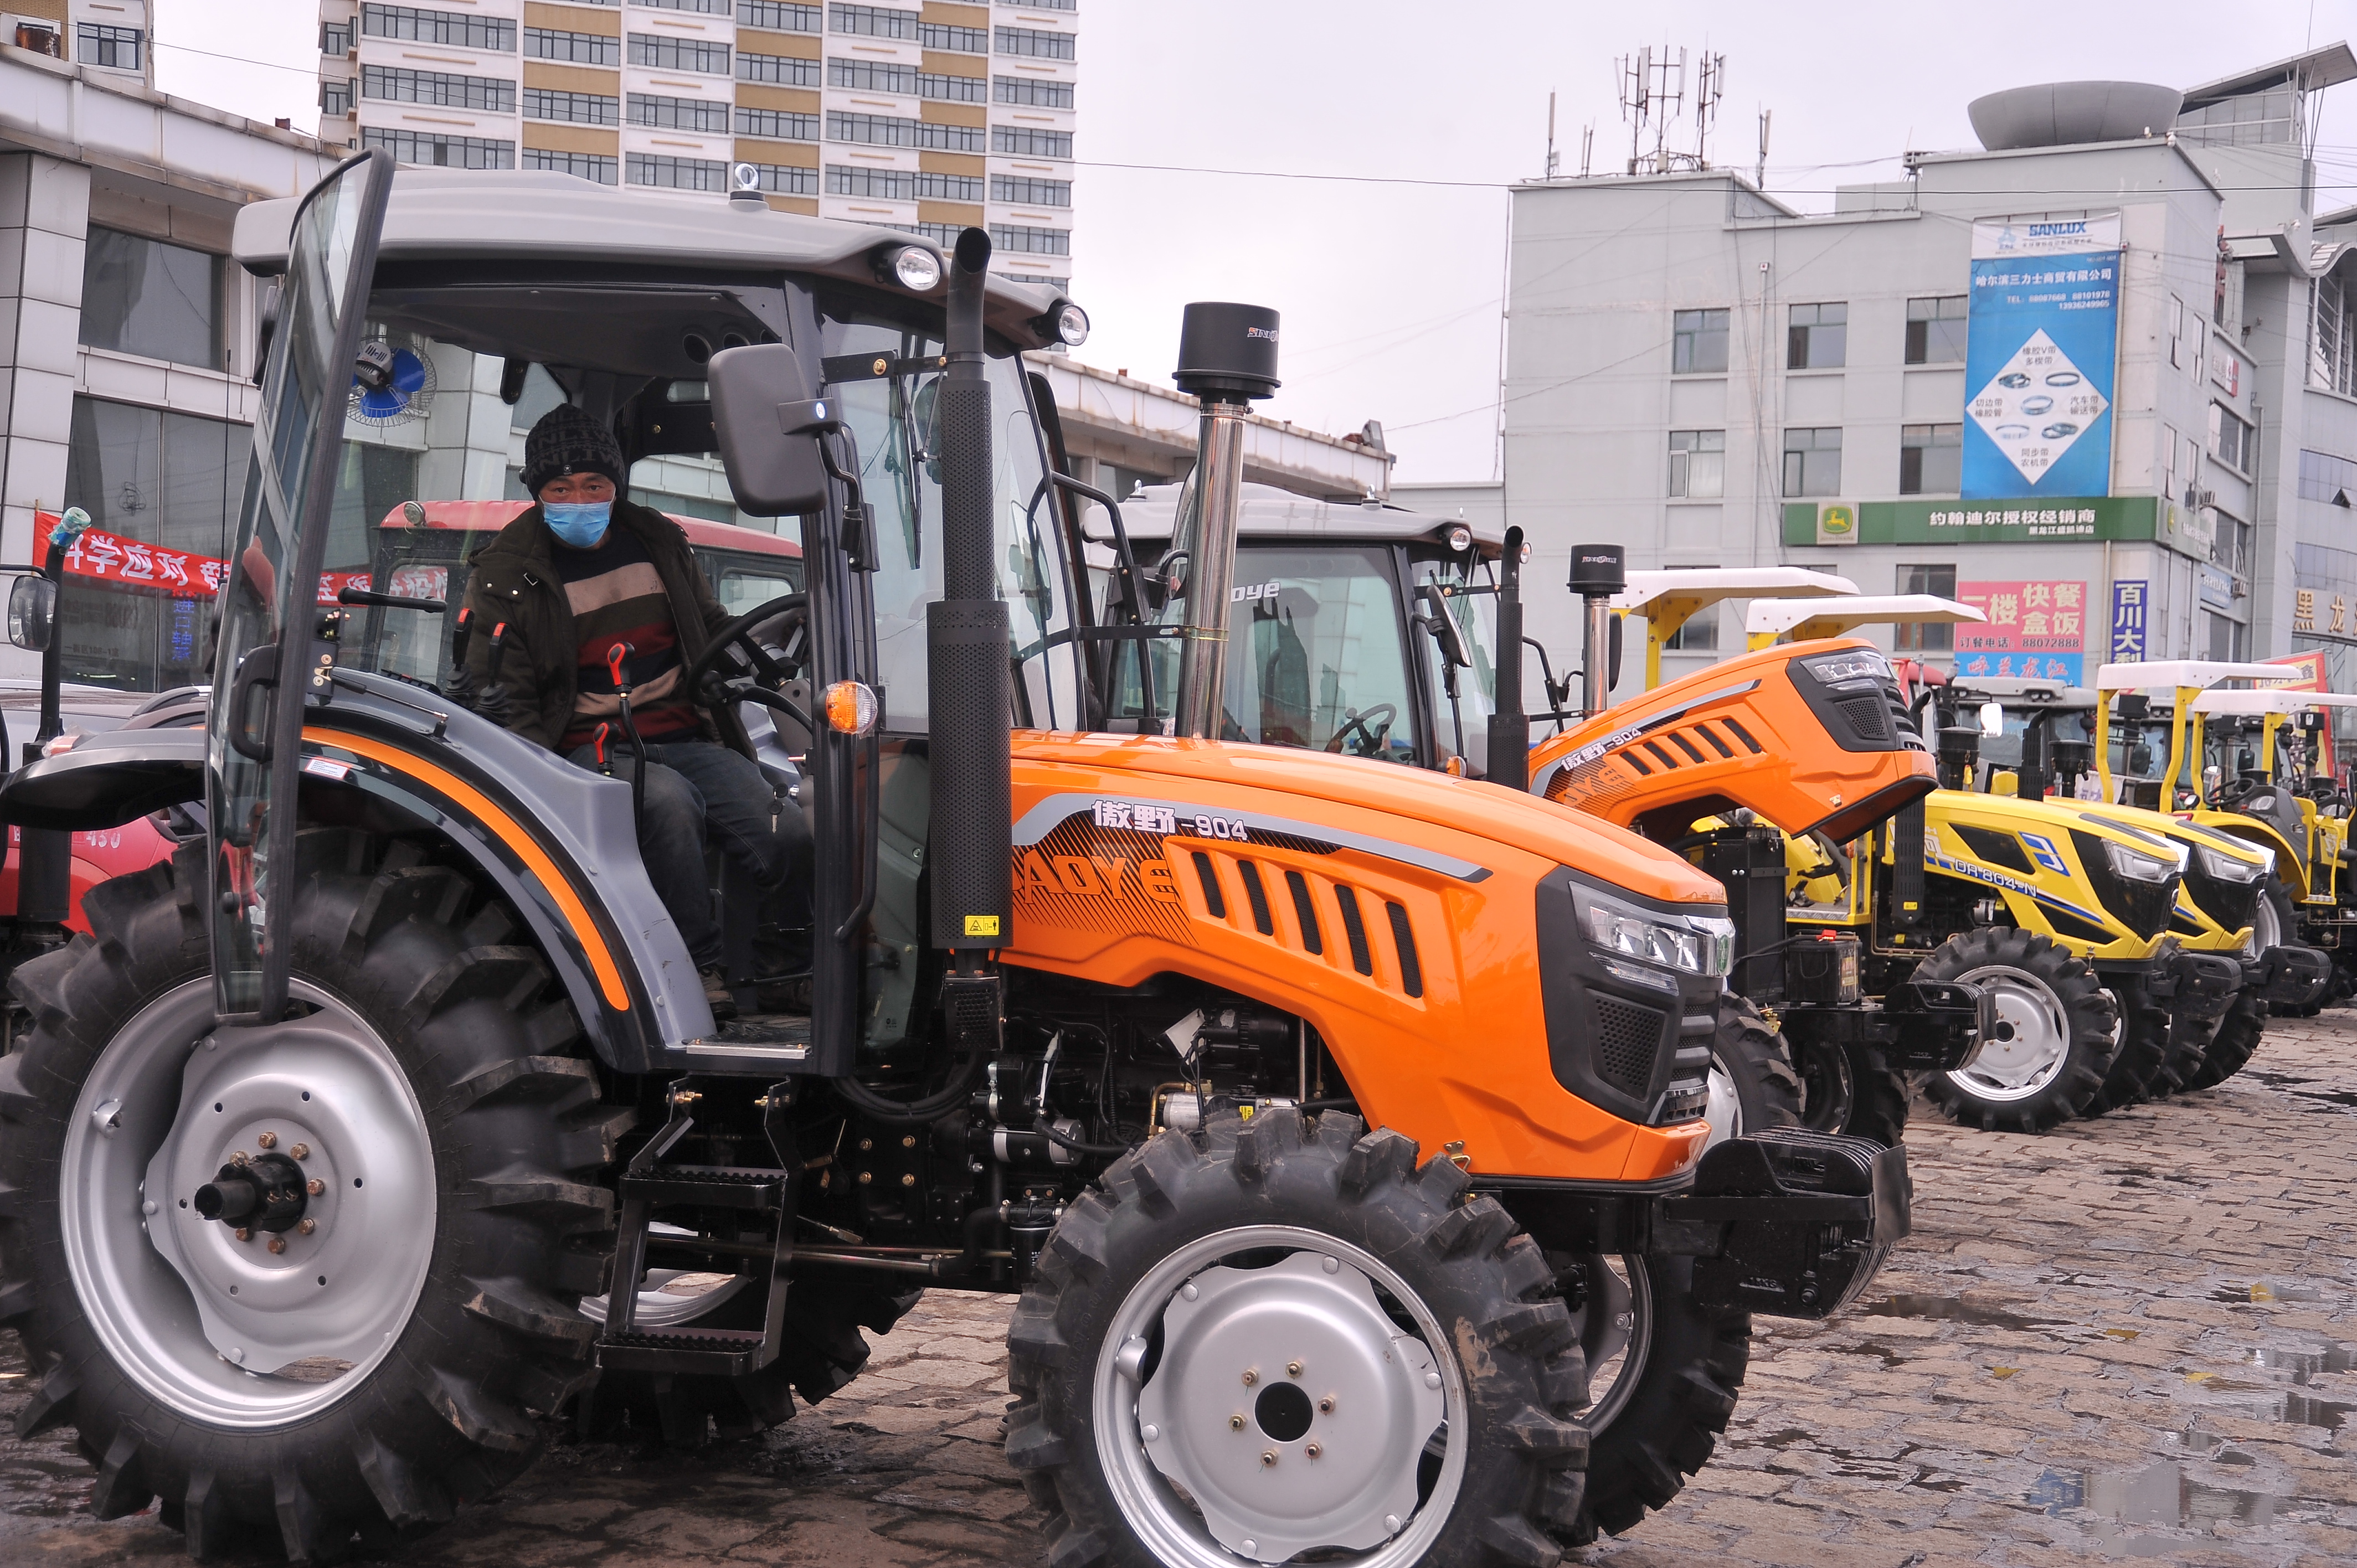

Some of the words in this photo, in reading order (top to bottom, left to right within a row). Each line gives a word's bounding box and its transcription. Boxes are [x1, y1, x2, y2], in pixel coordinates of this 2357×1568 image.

[2029, 221, 2087, 236] SANLUX
[1975, 268, 2112, 287] 哈尔滨三力士商贸有限公司
[2022, 345, 2057, 354] 橡胶V带
[1975, 398, 2003, 407] 切边带
[2070, 395, 2099, 405] 汽车带
[2021, 447, 2049, 457] 同步带
[2021, 457, 2049, 467] 农机带
[1929, 509, 2096, 526] 约翰迪尔授权经销商
[2023, 583, 2081, 608] 快餐
[2293, 590, 2357, 636] 黑龙
[2021, 610, 2080, 636] 盒饭
[2023, 638, 2080, 648] 88072888
[1012, 848, 1177, 904] AOYE
[1955, 859, 1978, 878] DR
[1982, 868, 2037, 898] 804-N
